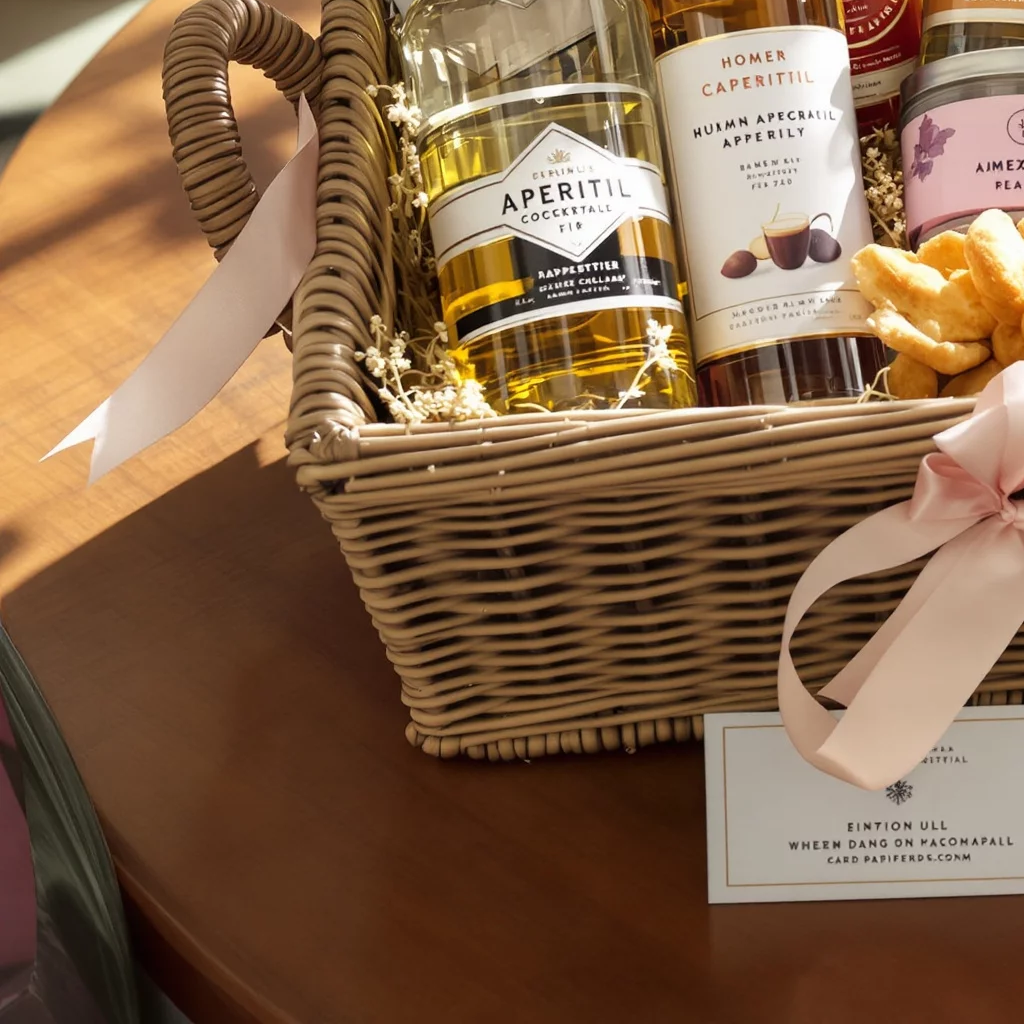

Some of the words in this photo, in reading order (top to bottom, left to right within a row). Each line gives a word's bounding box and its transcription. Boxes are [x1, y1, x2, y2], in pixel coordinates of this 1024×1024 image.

[721, 49, 787, 69] HOMER
[722, 127, 806, 149] APPERILY
[501, 178, 632, 216] APERITIL
[847, 820, 913, 832] EINTION
[919, 820, 948, 831] ULL
[848, 838, 888, 850] DANG
[894, 837, 914, 848] ON
